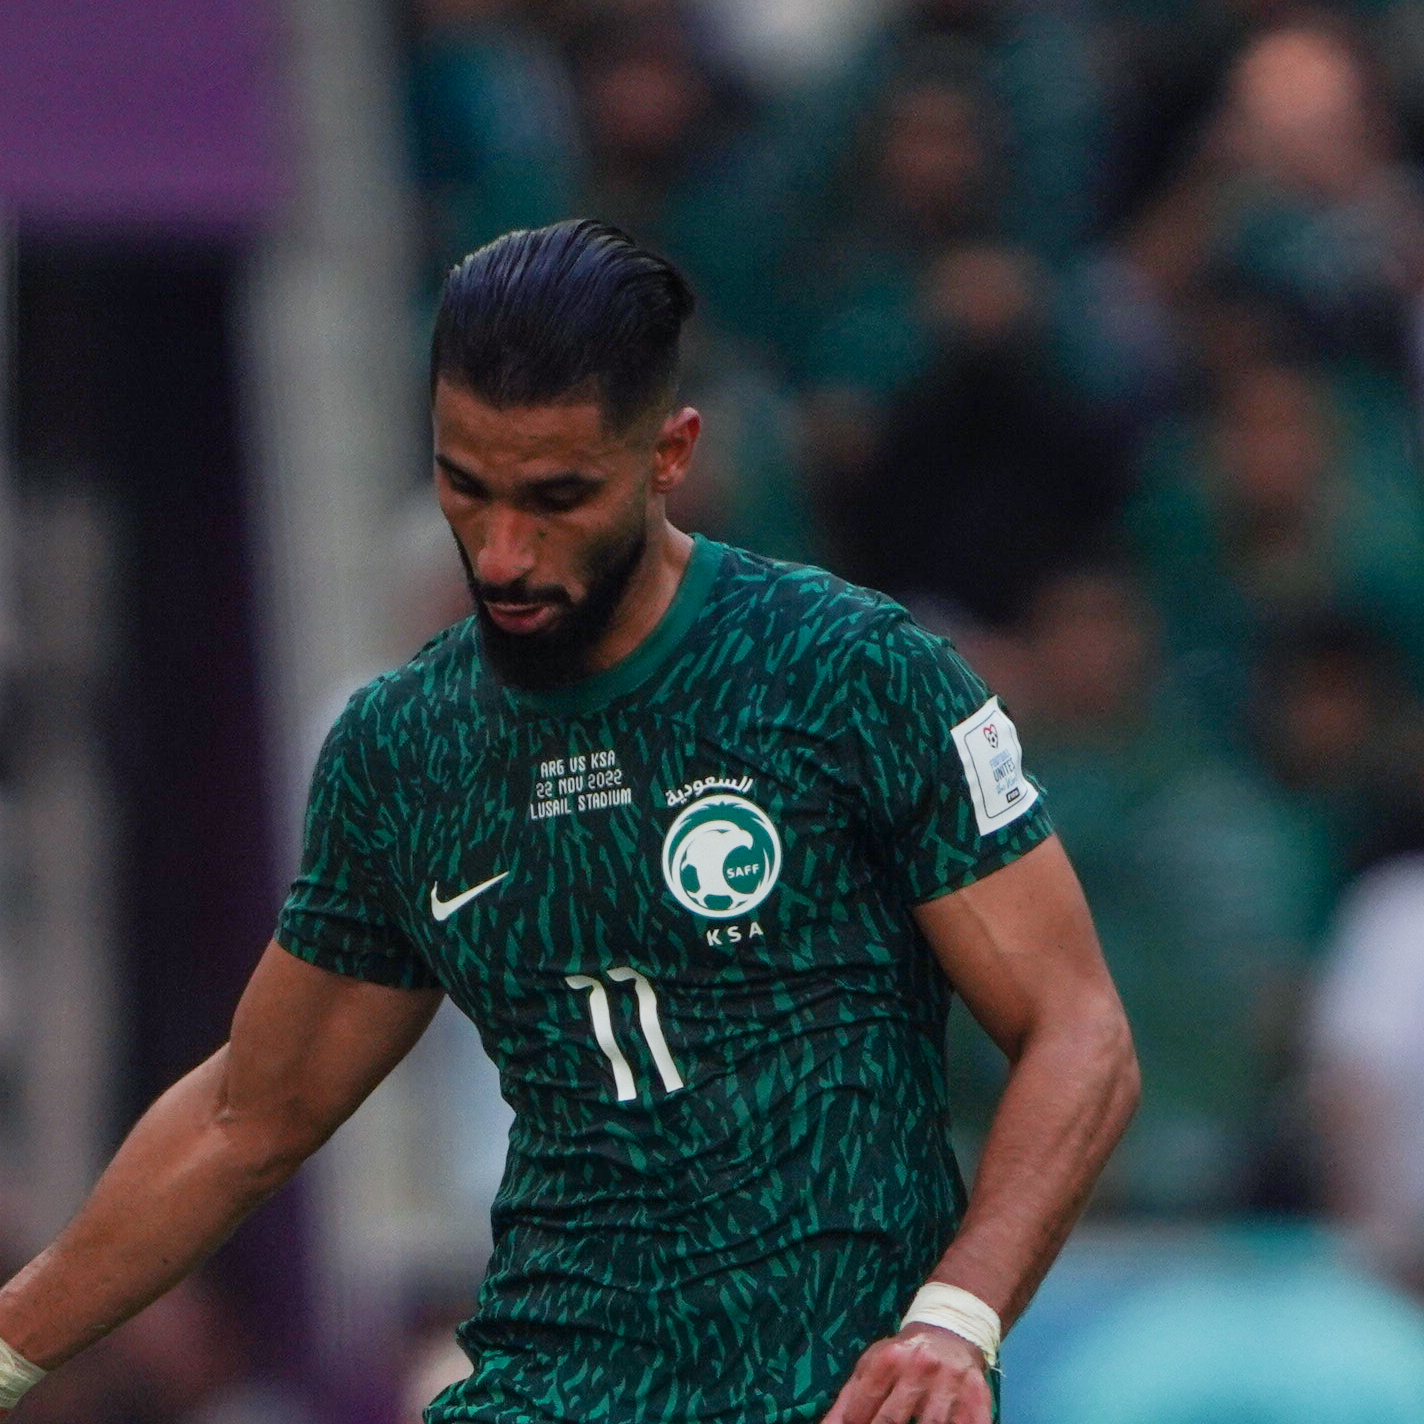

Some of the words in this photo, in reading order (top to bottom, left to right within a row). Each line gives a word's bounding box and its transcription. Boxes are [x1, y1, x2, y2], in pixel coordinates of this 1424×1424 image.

[540, 759, 565, 778] ARG
[590, 750, 616, 769] KSA
[536, 781, 553, 798] 22
[588, 769, 622, 789] 2022
[664, 775, 754, 807] السعودية
[530, 798, 572, 820] LUSAIL
[578, 788, 632, 811] STADIUM
[726, 863, 760, 879] SAFF
[706, 921, 764, 946] KSA
[564, 966, 684, 1101] 11
